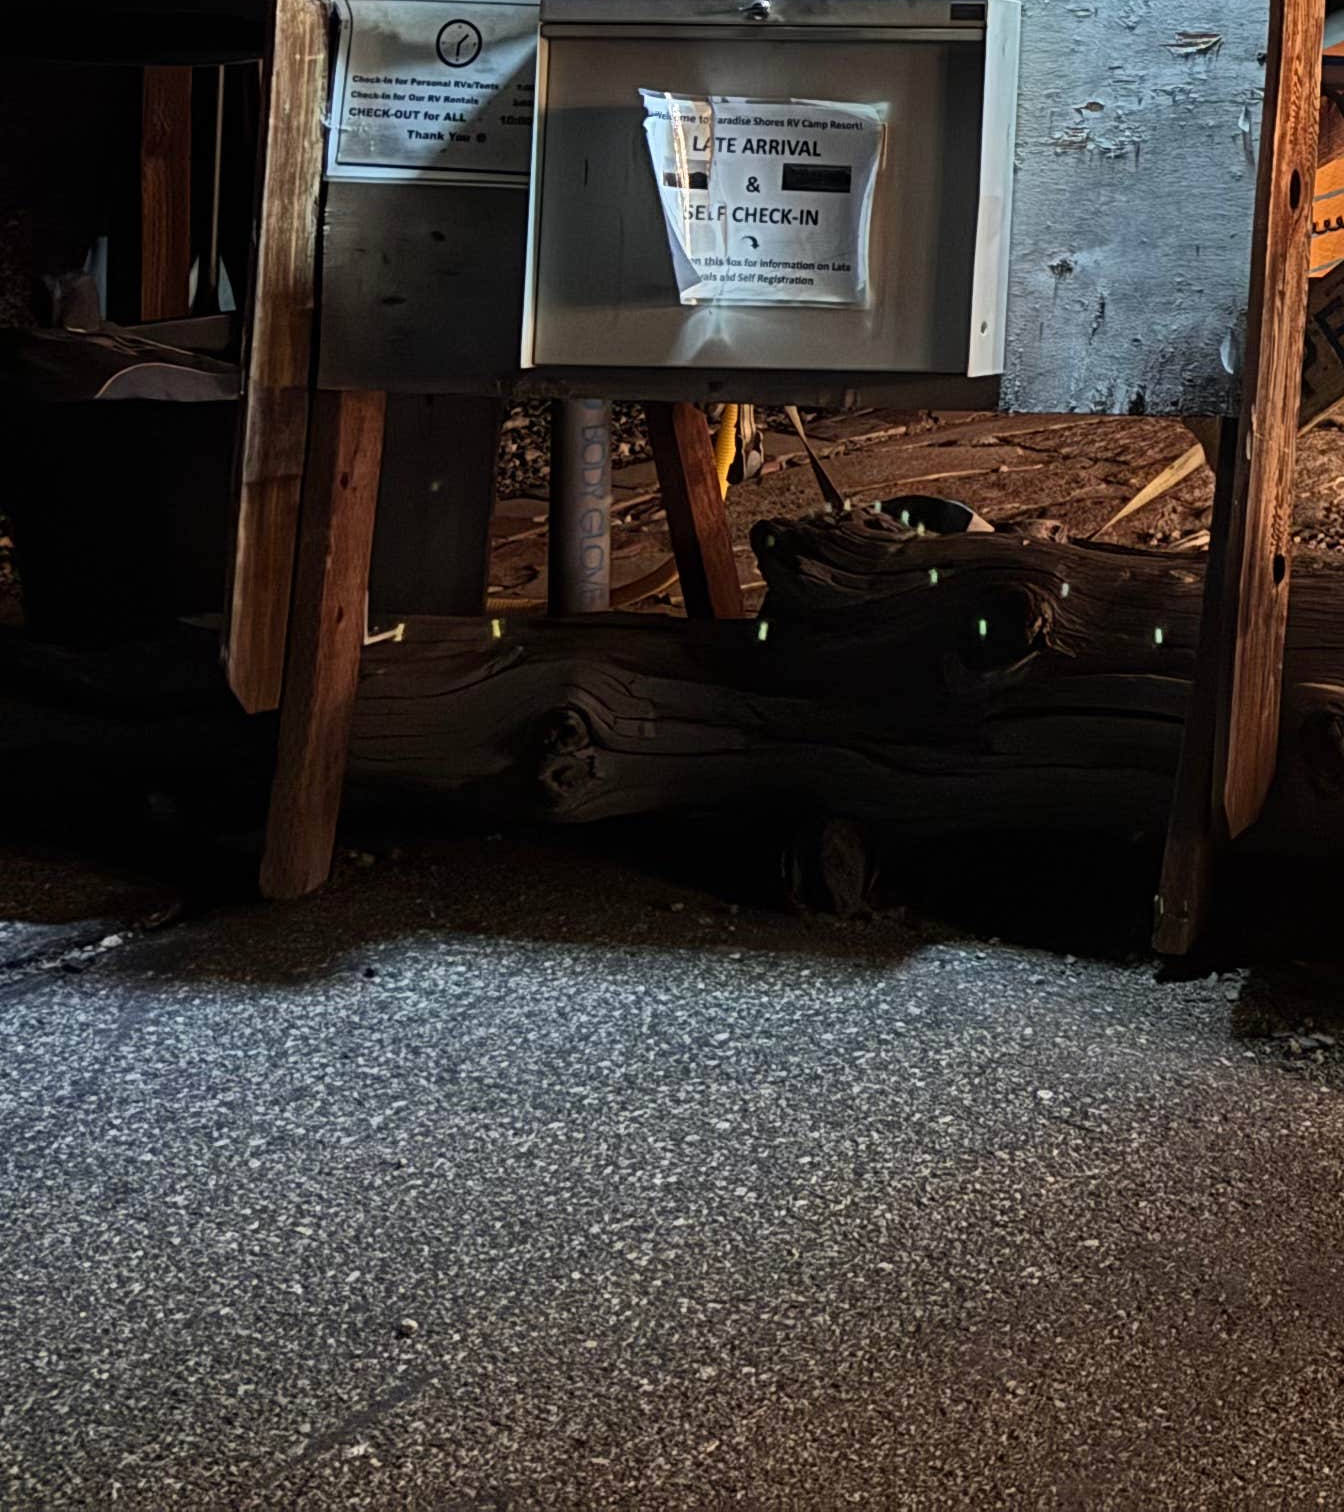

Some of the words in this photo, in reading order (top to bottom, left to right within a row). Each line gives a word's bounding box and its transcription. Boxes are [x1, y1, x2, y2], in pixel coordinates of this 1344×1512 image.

[395, 75, 408, 85] for
[410, 77, 452, 88] Personal
[393, 91, 406, 101] for
[408, 93, 426, 102] Our
[427, 95, 441, 103] RV
[443, 96, 479, 106] Rentals
[349, 107, 420, 120] CHECK-OUT
[423, 111, 440, 121] for
[443, 112, 466, 123] ALL
[699, 110, 709, 125] to
[716, 116, 751, 127] aradise
[753, 116, 785, 128] Shores
[787, 118, 800, 129] RV
[802, 119, 829, 132] Camp
[407, 129, 444, 141] Thank
[449, 131, 471, 143] You
[742, 139, 822, 158] ARRIVAL
[745, 175, 761, 194] &
[732, 206, 820, 226] CHECK-IN
[704, 255, 724, 266] this
[744, 257, 758, 268] for
[759, 259, 815, 271] information
[817, 263, 830, 272] on
[831, 261, 852, 272] Late
[738, 273, 756, 283] Self
[757, 274, 814, 286] Registration
